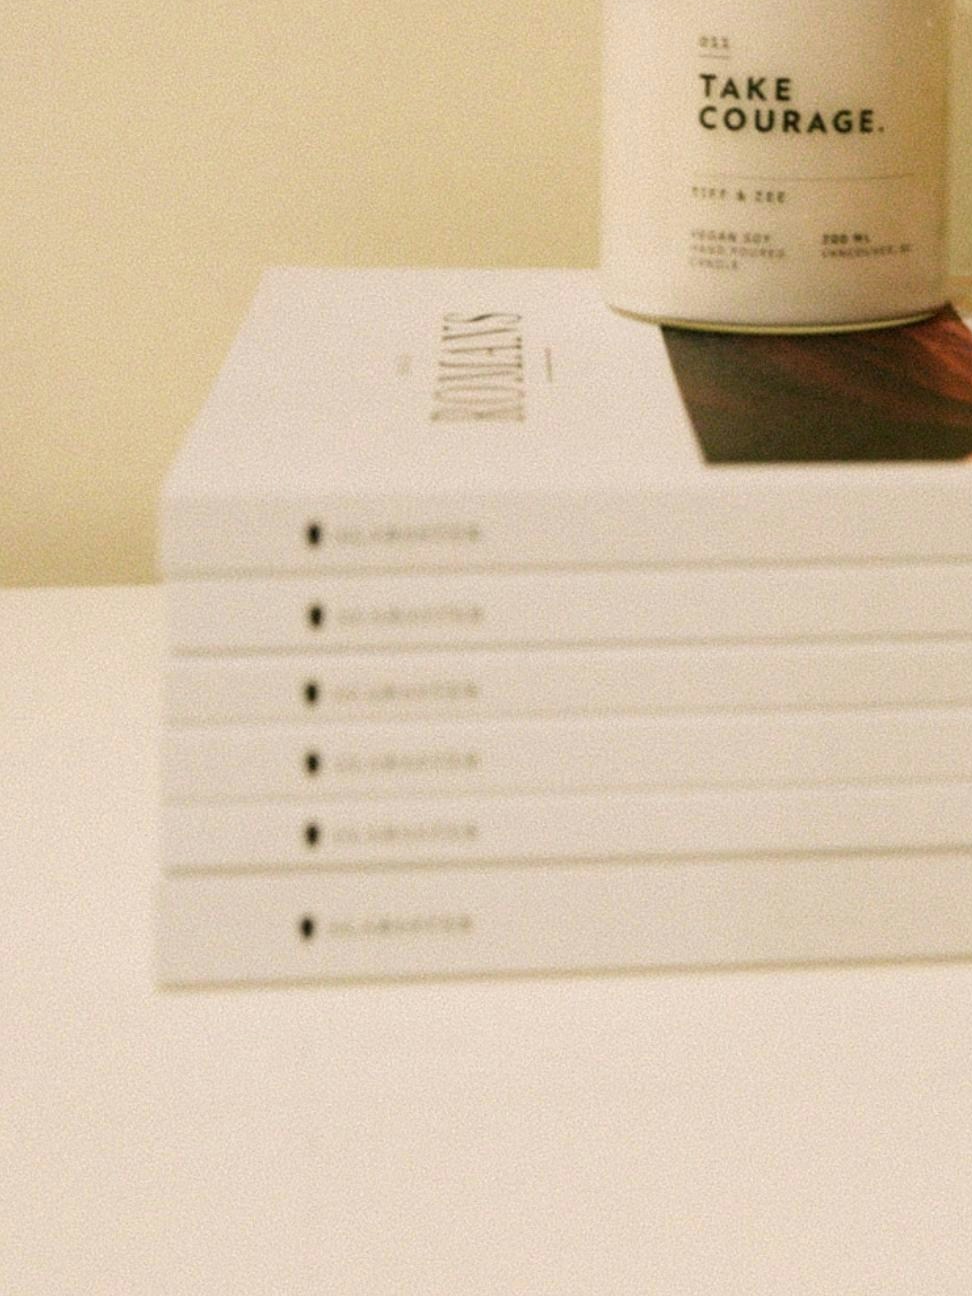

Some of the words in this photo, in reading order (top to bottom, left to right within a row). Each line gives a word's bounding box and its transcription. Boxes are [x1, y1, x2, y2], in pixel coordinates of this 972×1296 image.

[699, 73, 792, 102] TAKE
[699, 105, 885, 134] COURAGE.
[431, 313, 526, 424] ROMANS
